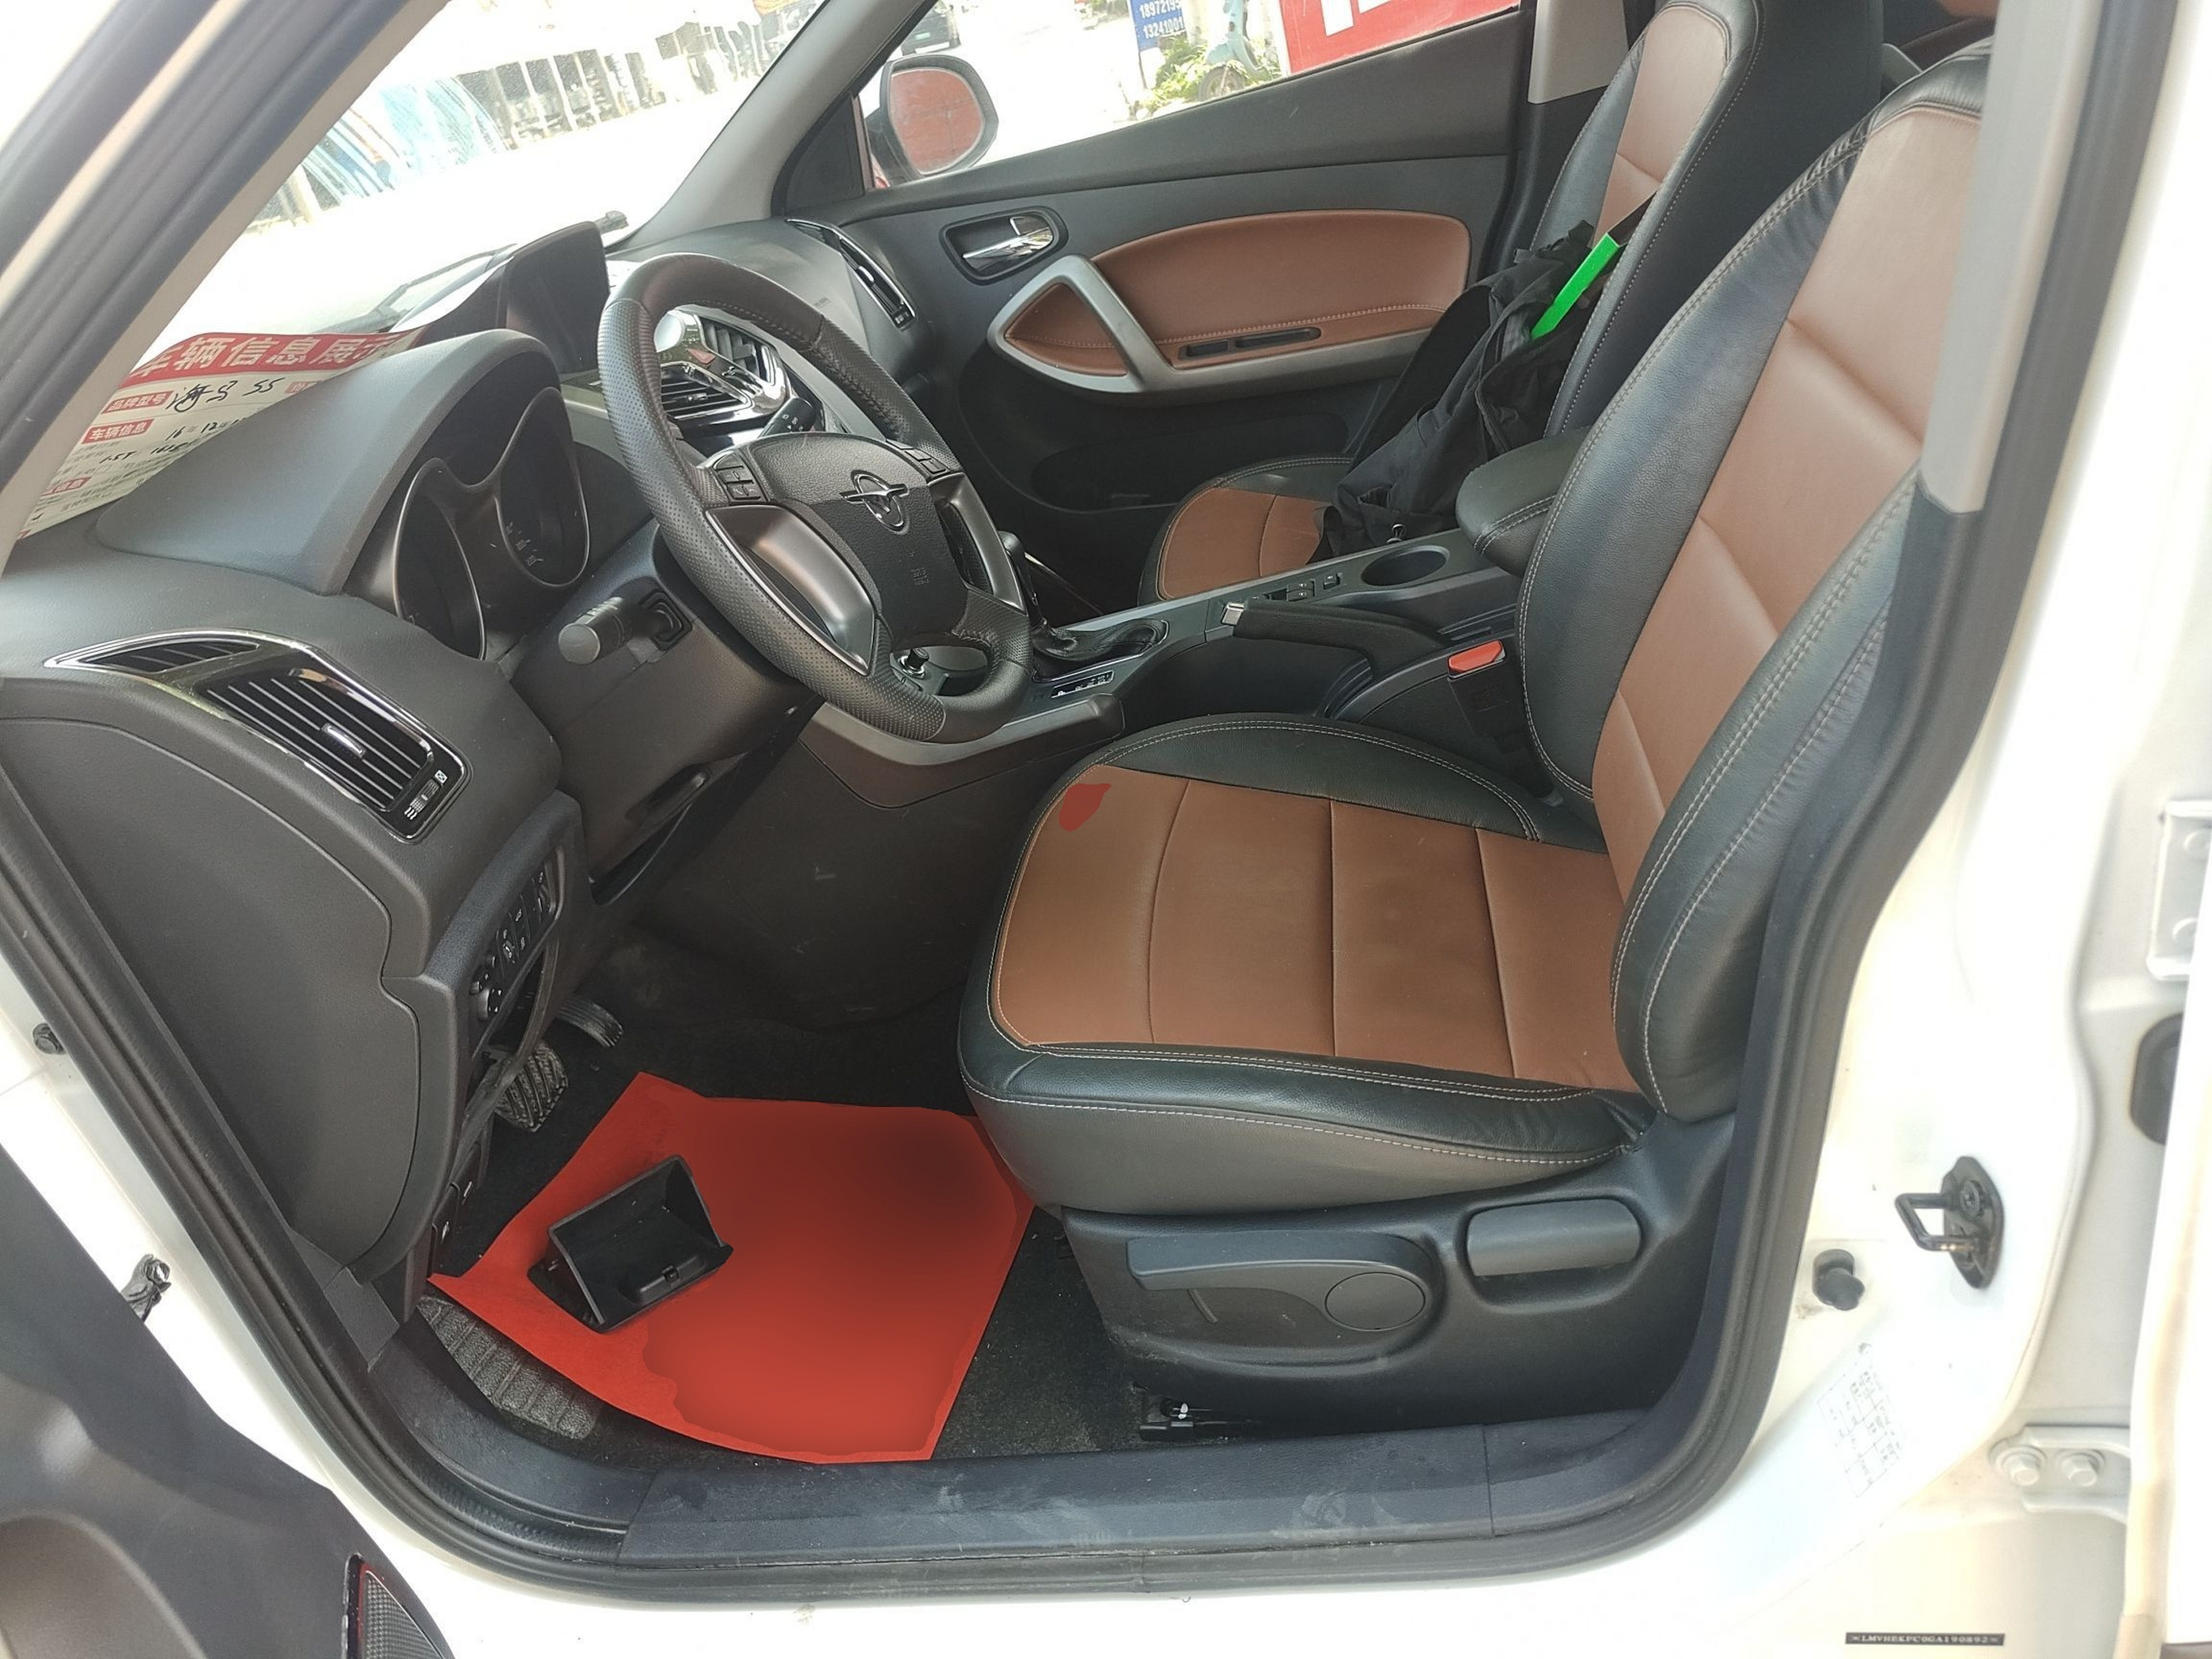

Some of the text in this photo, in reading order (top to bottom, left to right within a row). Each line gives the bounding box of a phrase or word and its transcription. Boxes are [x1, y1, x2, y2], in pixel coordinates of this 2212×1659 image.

[107, 392, 167, 411] 品牌型号
[89, 422, 148, 440] 车辆信息
